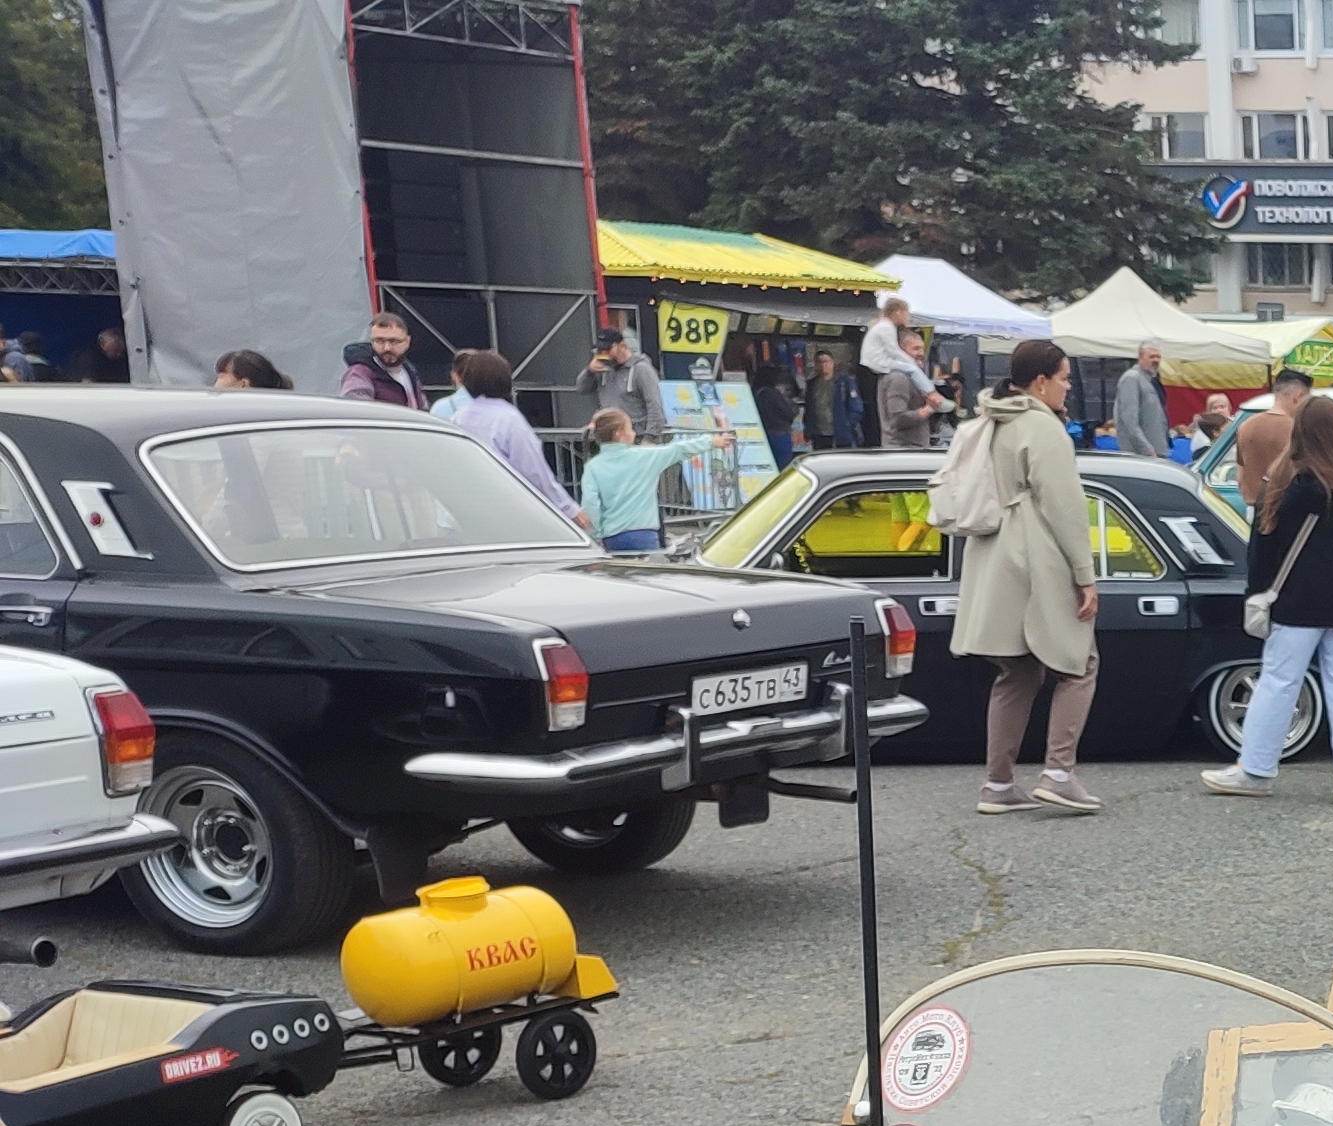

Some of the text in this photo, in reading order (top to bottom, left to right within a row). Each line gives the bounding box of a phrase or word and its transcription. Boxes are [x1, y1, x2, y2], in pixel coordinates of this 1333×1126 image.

[666, 316, 720, 345] 98Р
[699, 676, 777, 710] С635ТВ
[782, 667, 801, 688] 43
[466, 936, 537, 973] КВАС
[164, 1050, 222, 1080] DRIVE2.RU
